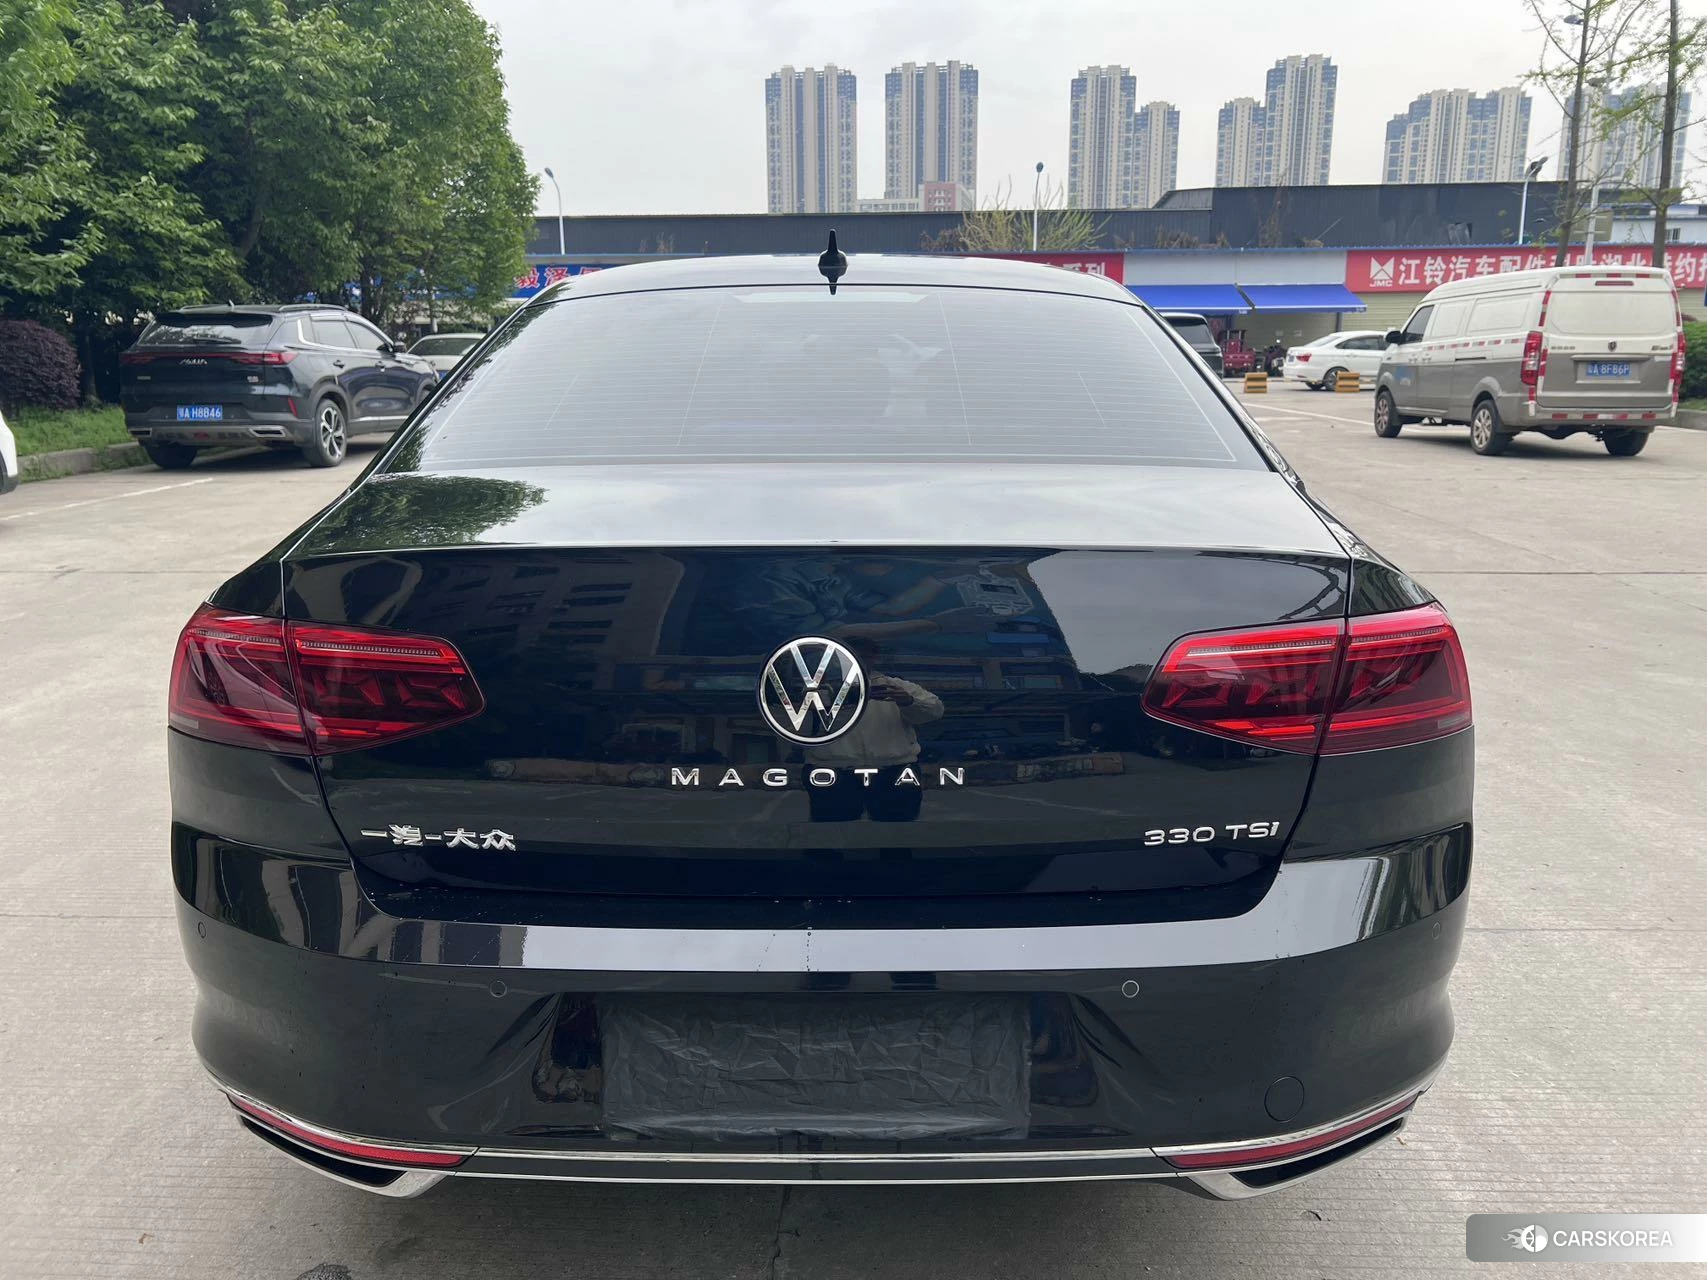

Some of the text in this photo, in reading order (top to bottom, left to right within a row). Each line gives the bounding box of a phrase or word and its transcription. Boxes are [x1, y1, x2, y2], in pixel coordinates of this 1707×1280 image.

[1369, 279, 1393, 288] JMC
[670, 766, 966, 787] MAGOTAN
[1144, 821, 1280, 846] 330 TSI
